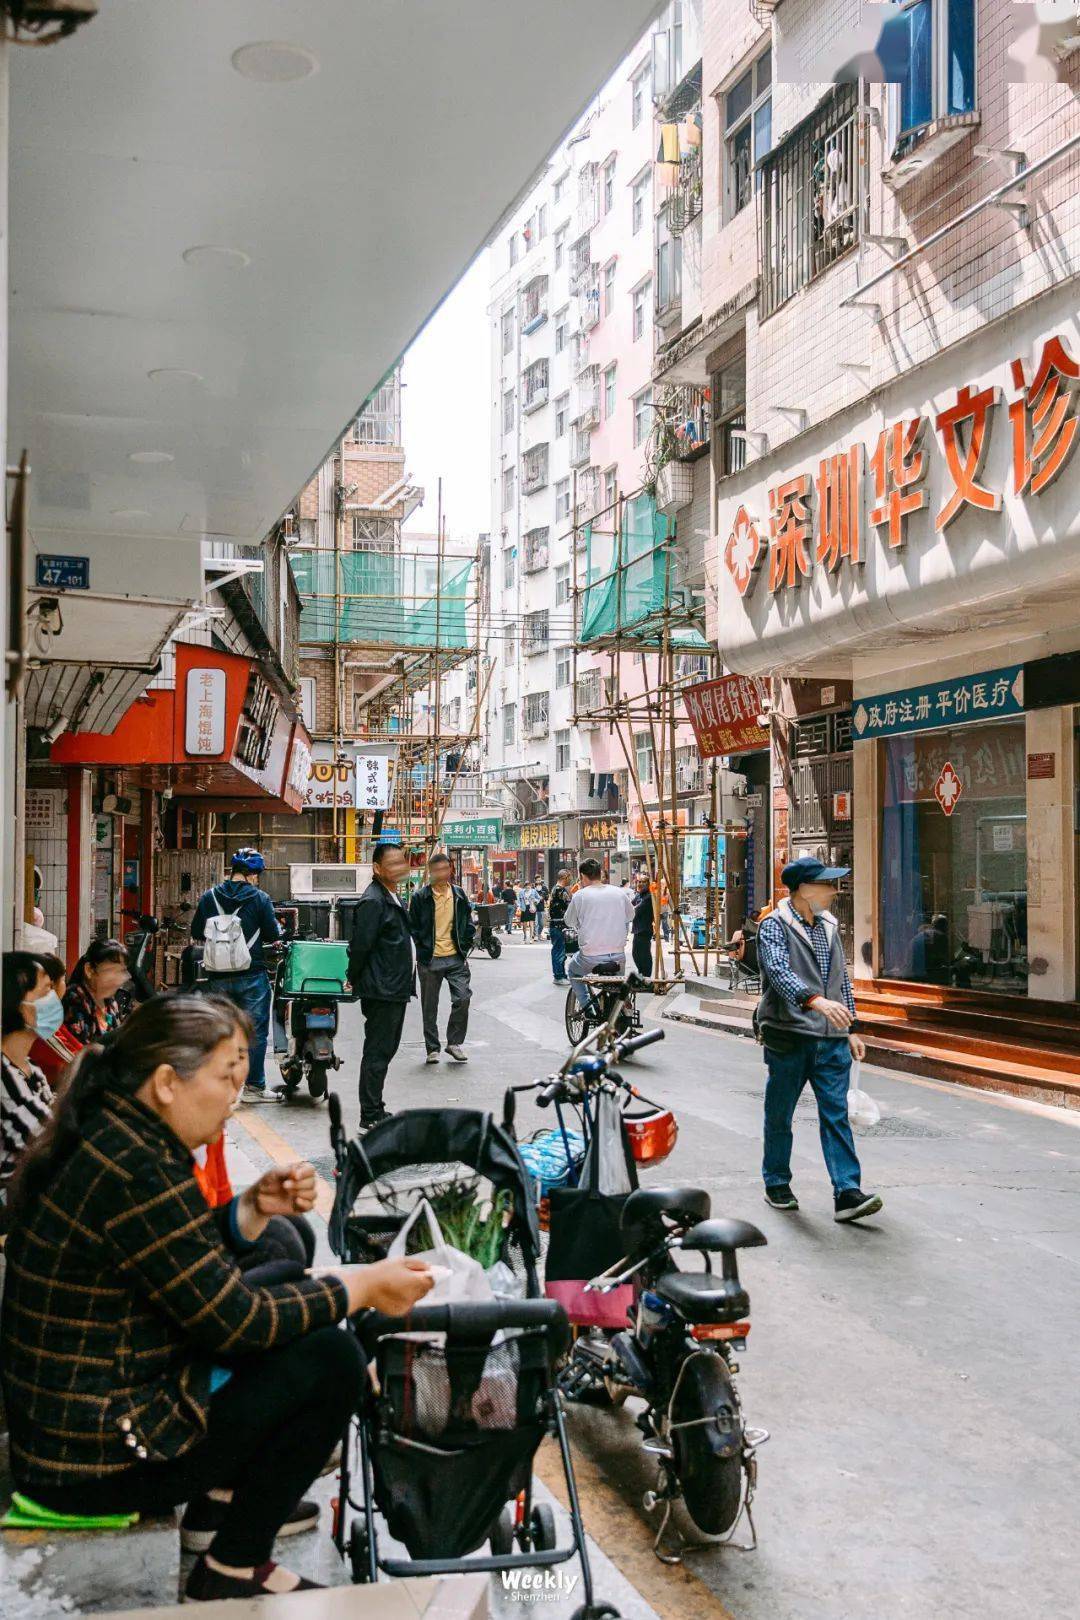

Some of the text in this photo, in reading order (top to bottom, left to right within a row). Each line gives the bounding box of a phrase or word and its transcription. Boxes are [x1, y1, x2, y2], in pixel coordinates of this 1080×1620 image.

[768, 335, 1080, 593] 深圳华文诊
[43, 569, 83, 586] 47-101
[198, 672, 214, 752] 老上海馄饨
[868, 695, 932, 728] 政府注册
[936, 677, 1010, 718] 平价医疗
